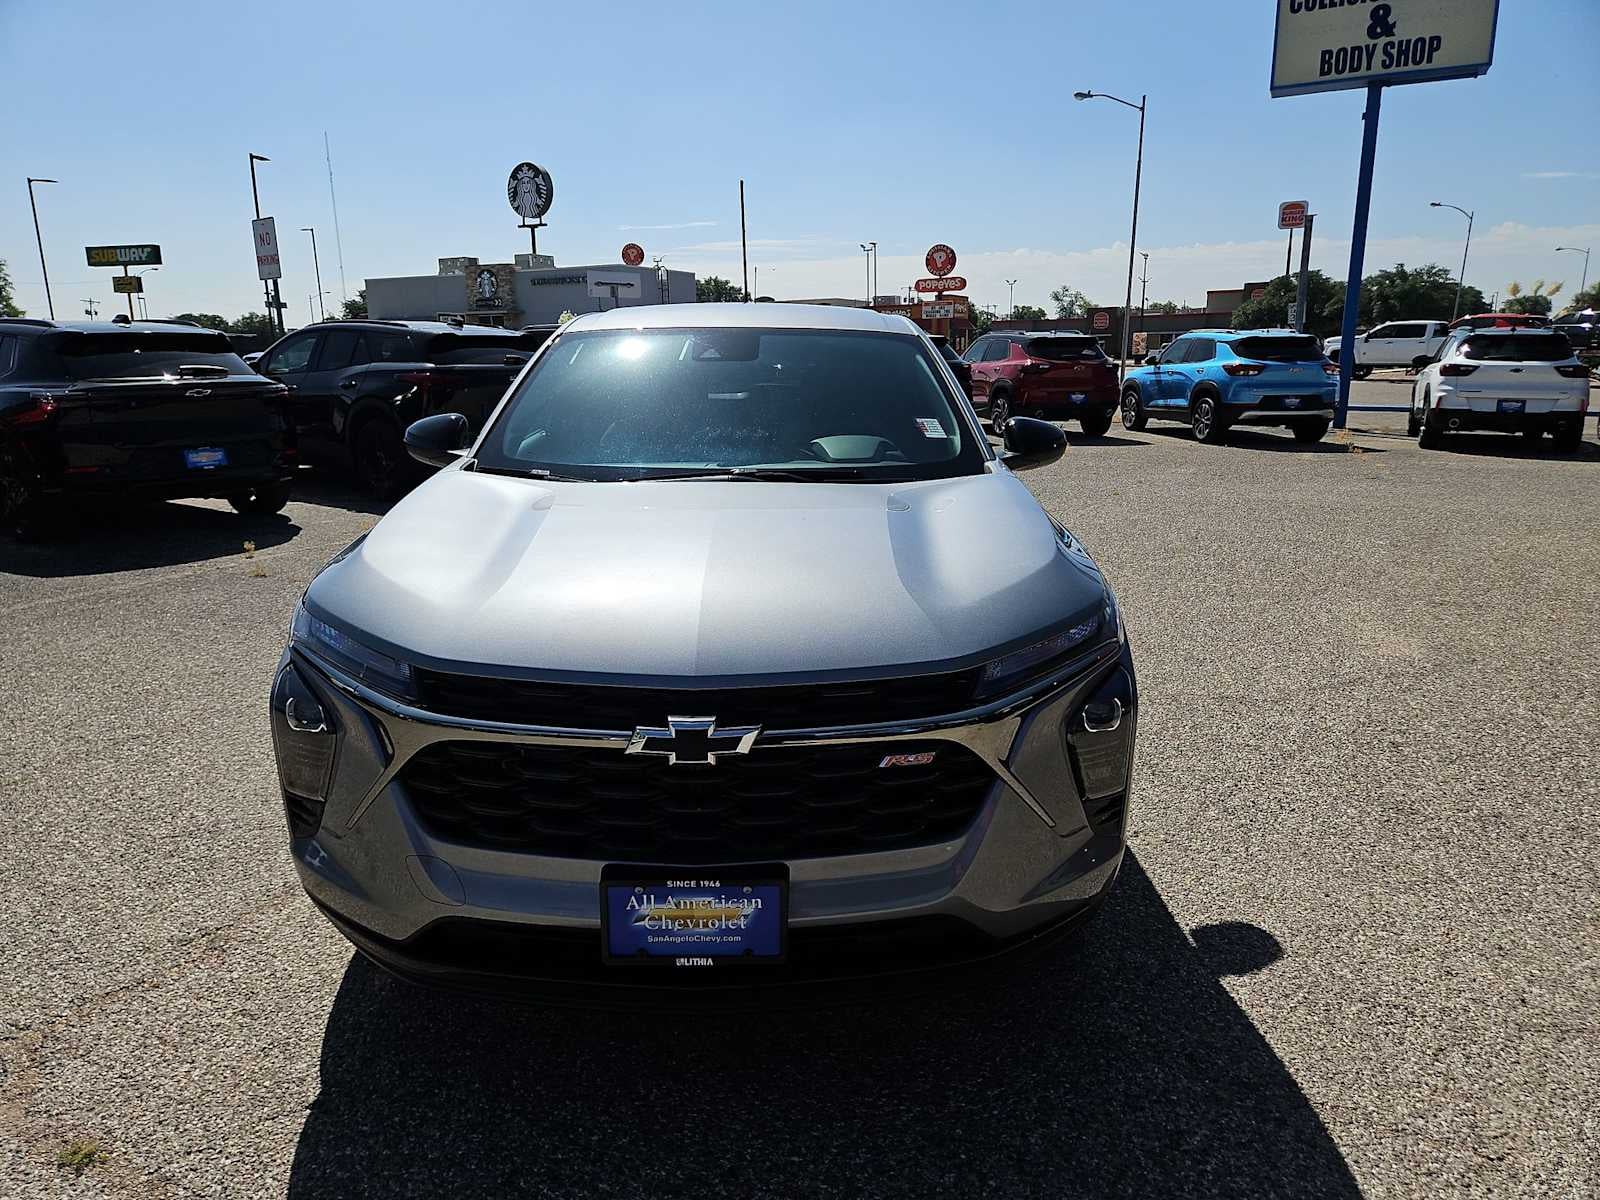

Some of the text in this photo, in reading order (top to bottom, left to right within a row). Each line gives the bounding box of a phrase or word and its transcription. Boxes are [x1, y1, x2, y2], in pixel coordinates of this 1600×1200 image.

[1366, 4, 1396, 40] &
[1319, 35, 1442, 77] BODY SHOP
[1281, 214, 1304, 223] KING
[258, 231, 271, 247] NO
[90, 247, 152, 263] SUBWAY
[879, 752, 936, 768] RS
[667, 880, 721, 888] SINCE 1946
[626, 895, 762, 910] All American
[645, 914, 746, 930] Chevrolet
[648, 935, 741, 944] SanAngeloChevy.com
[684, 957, 714, 966] LITHIA
